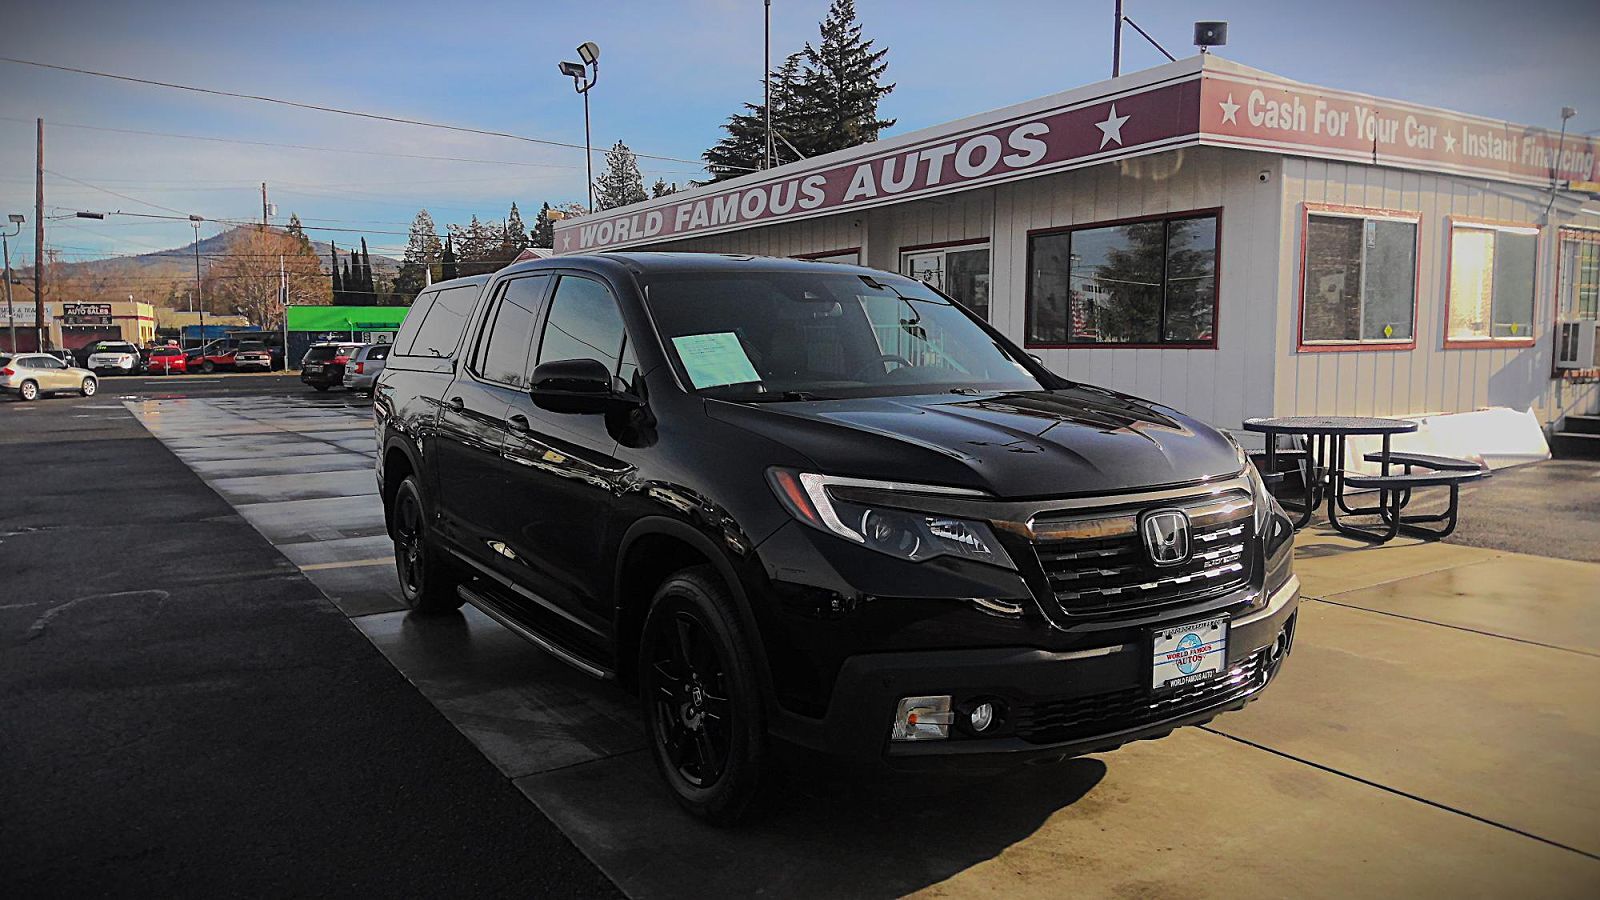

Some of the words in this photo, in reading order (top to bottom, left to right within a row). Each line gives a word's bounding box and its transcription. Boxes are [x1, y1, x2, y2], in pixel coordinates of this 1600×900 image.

[1247, 89, 1307, 132] Cash
[1314, 100, 1349, 137] For
[1354, 105, 1399, 144] Your
[1404, 115, 1437, 149] Car
[1462, 126, 1518, 163] Instant
[579, 210, 663, 249] WORLD
[674, 174, 827, 232] FAMOUS
[842, 122, 1050, 202] AUTOS
[87, 307, 109, 315] SALES
[1166, 650, 1188, 660] WORLD
[1189, 644, 1212, 655] FAMOUS
[1177, 654, 1203, 665] AUTOS
[1170, 676, 1186, 688] WORLD
[1185, 673, 1202, 684] FAMOUS
